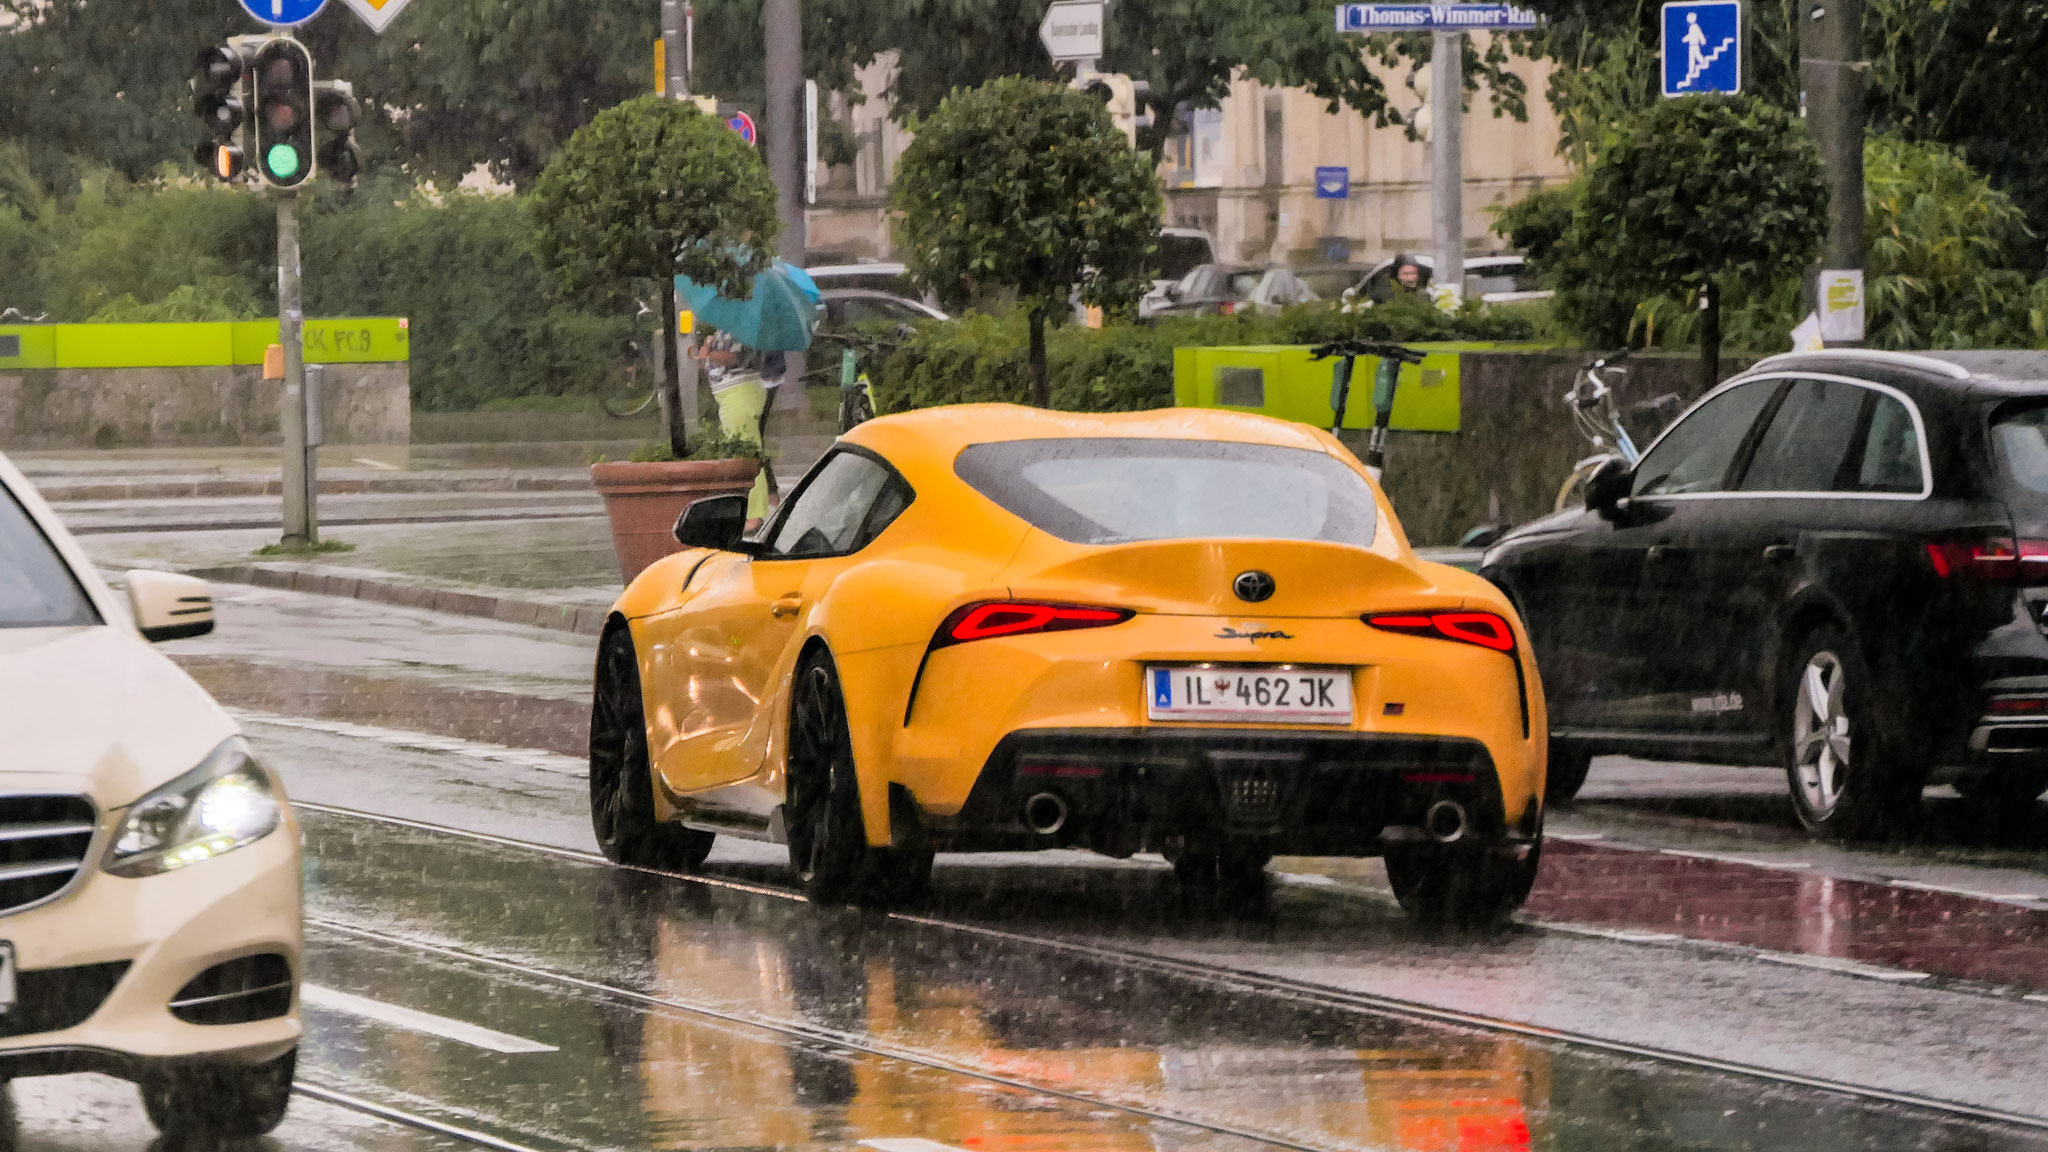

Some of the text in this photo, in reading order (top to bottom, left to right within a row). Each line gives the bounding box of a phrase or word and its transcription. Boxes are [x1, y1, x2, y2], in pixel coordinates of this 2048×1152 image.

[1213, 627, 1295, 645] Supra
[1185, 675, 1335, 707] IL 462 JK
